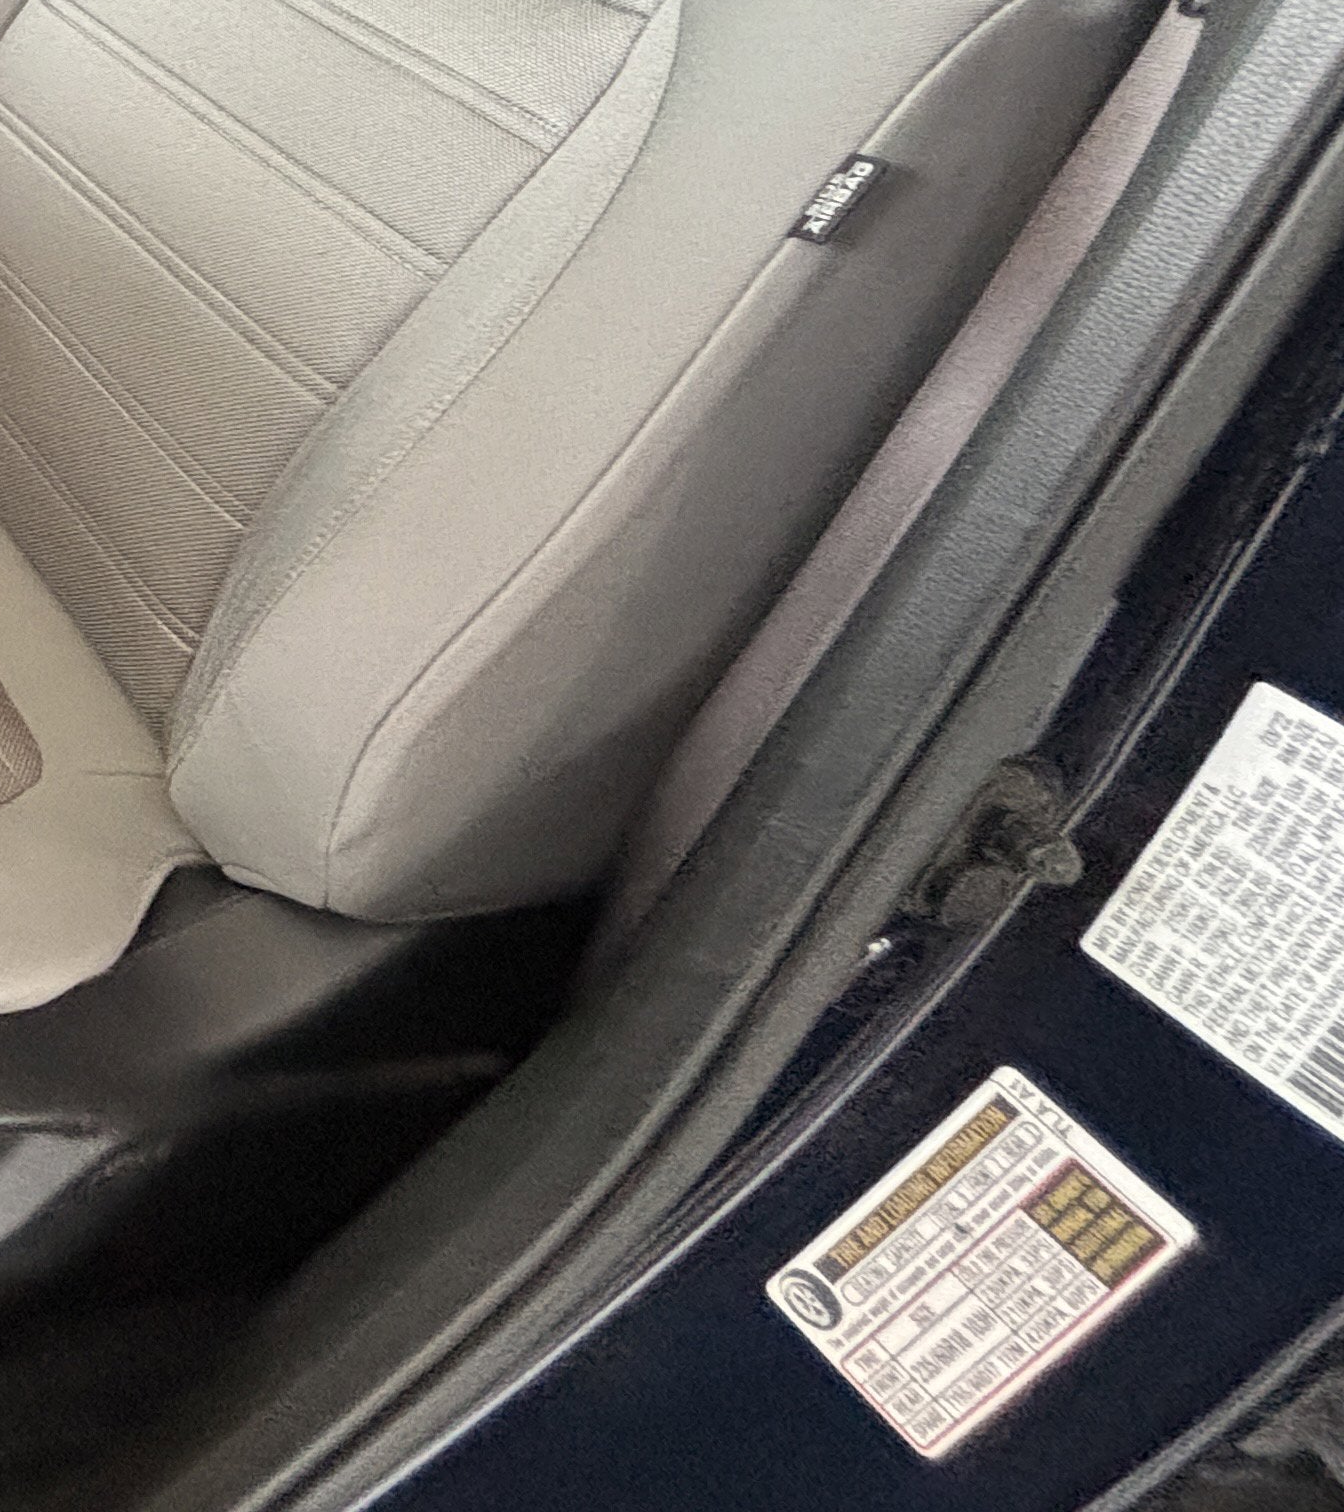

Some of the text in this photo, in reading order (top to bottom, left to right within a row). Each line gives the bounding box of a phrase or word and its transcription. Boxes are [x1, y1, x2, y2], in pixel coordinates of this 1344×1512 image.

[828, 1232, 867, 1271] TIRE
[852, 1211, 891, 1249] AND
[875, 1168, 937, 1229] LOADING
[922, 1101, 1010, 1185] INFORMATION
